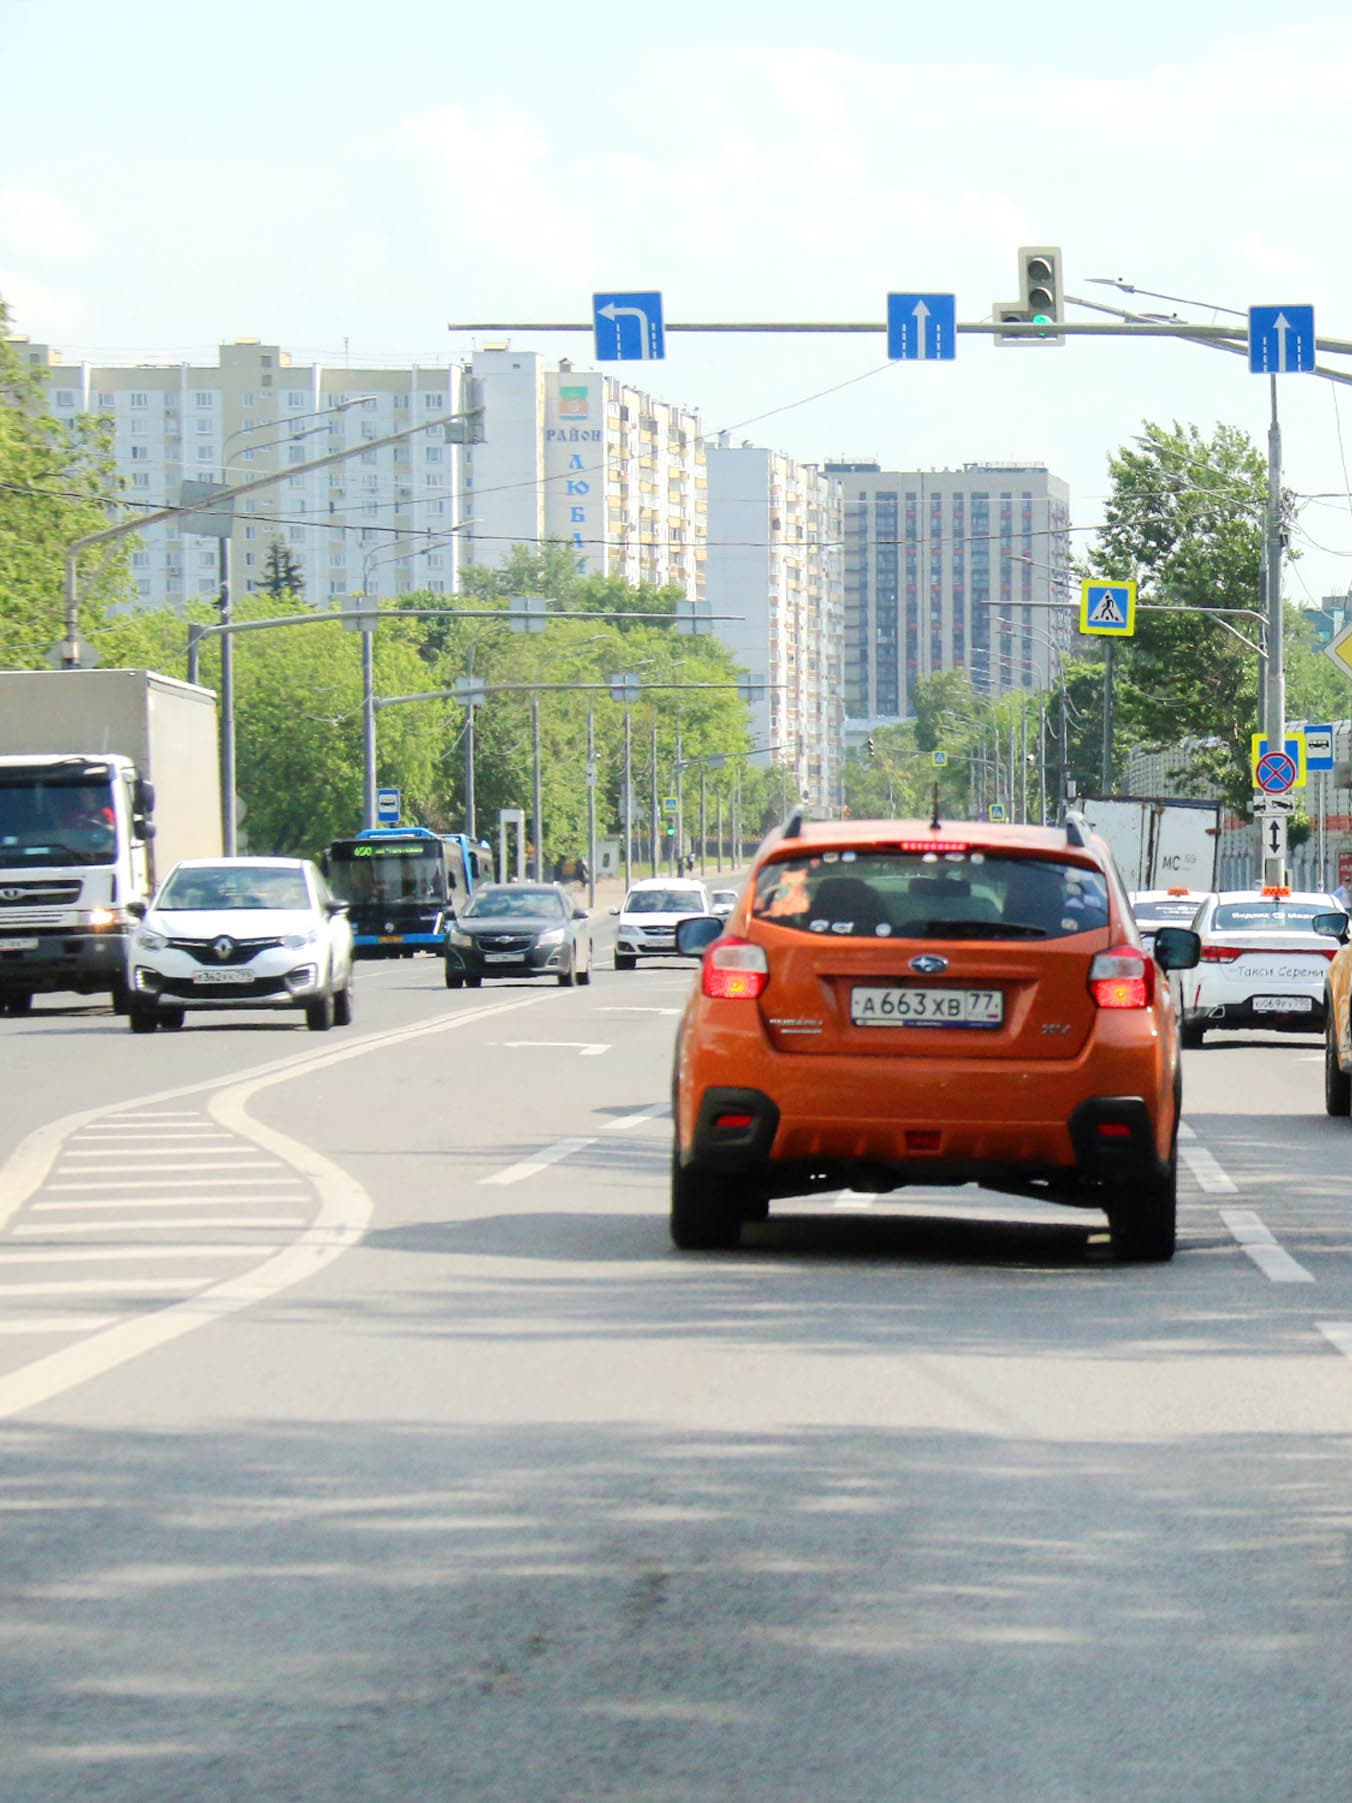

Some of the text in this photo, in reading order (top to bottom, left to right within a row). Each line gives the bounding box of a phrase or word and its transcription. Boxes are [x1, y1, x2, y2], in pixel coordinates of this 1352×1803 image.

[546, 428, 602, 442] РАЙОН
[1239, 966, 1274, 977] Такси
[862, 992, 993, 1016] А663ХВ 77
